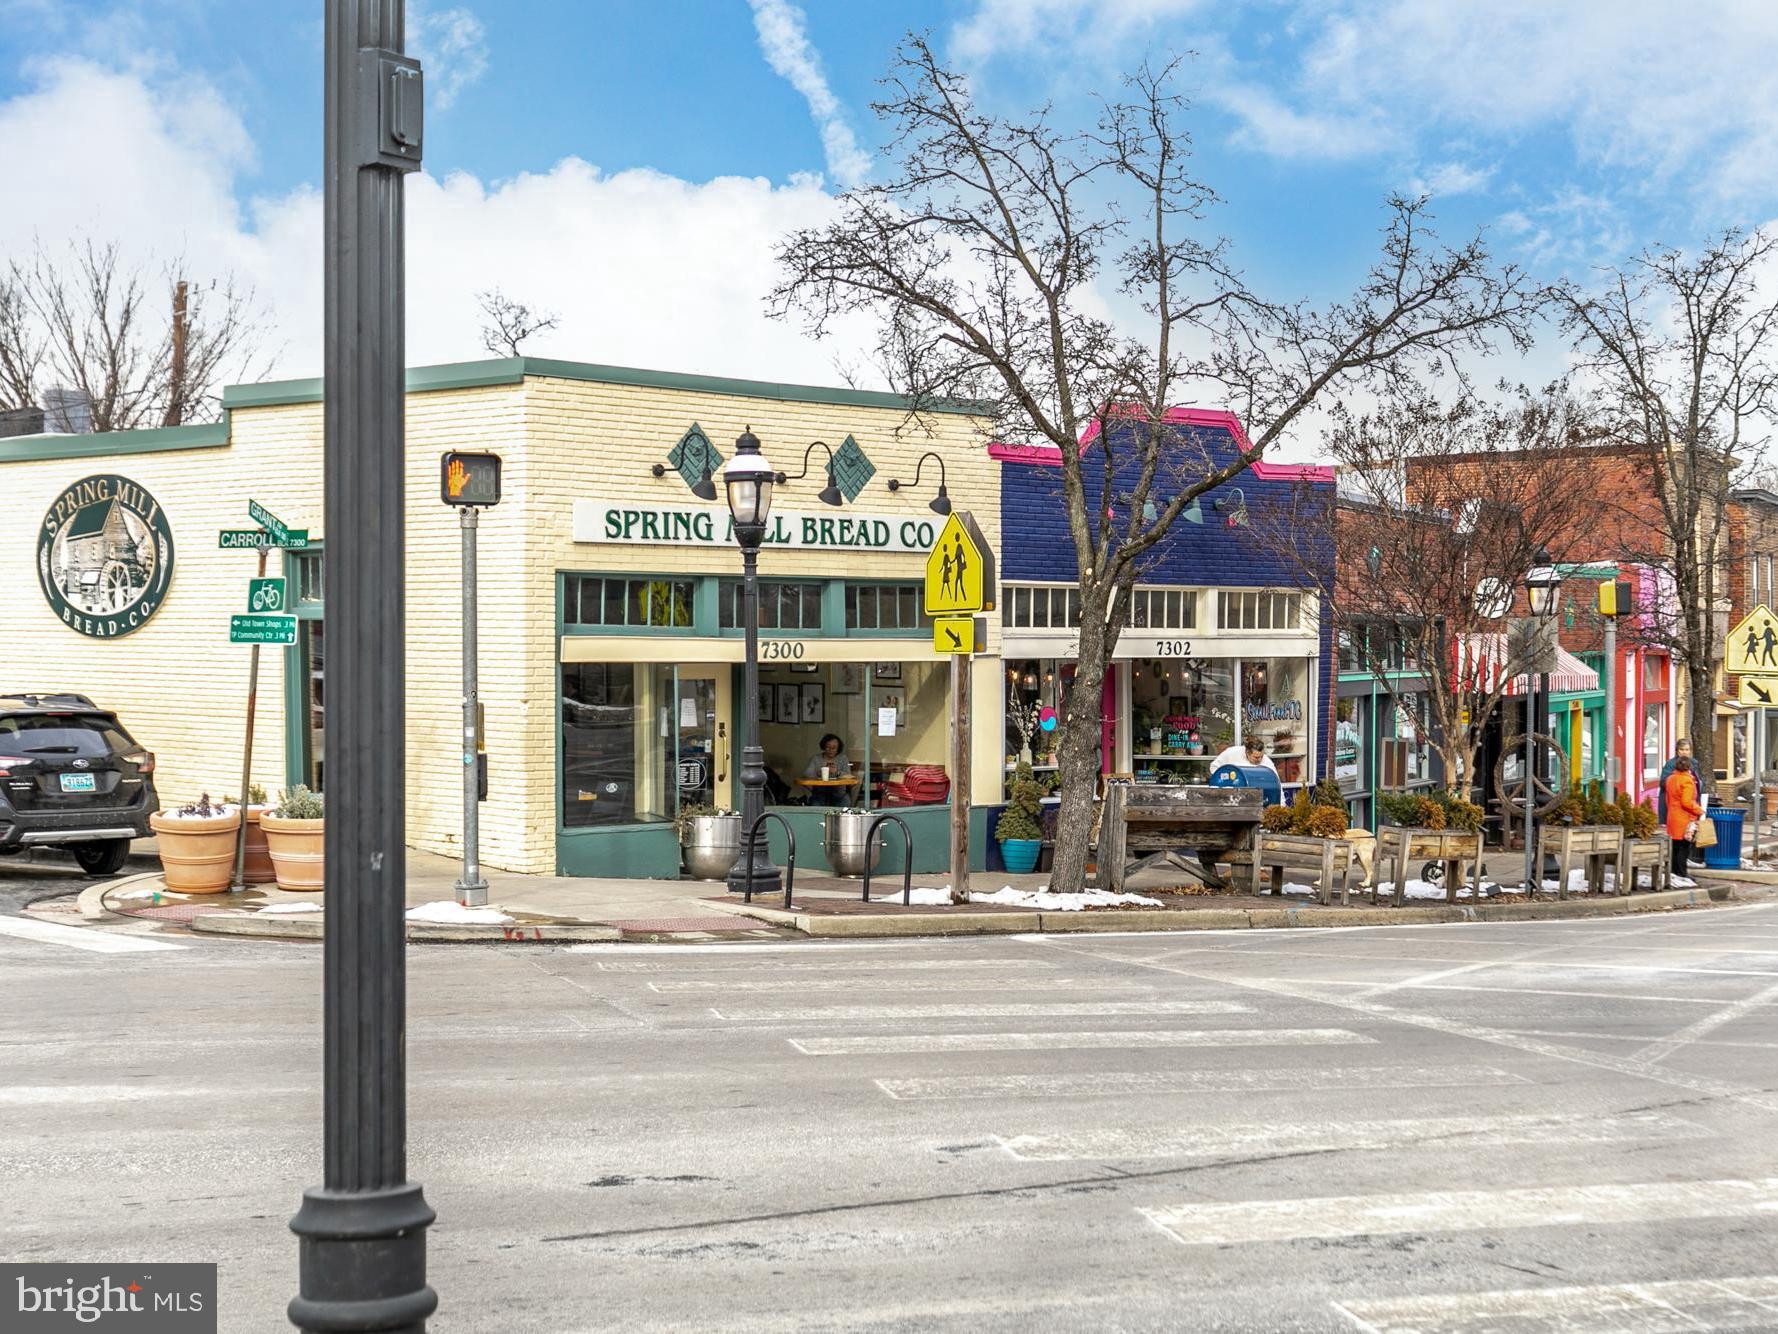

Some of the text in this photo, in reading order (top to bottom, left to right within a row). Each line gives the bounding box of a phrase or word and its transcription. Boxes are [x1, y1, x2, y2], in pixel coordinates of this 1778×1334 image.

[45, 479, 161, 538] SPRING MILL
[605, 509, 713, 541] SPRING
[801, 517, 890, 546] BREAD
[899, 521, 934, 548] CO
[221, 533, 276, 547] CARROLL
[289, 539, 306, 547] 7300
[62, 605, 117, 635] BREAD
[265, 620, 281, 629] Shops
[237, 632, 264, 640] Community
[761, 641, 804, 659] 7300
[1157, 641, 1191, 656] 7302
